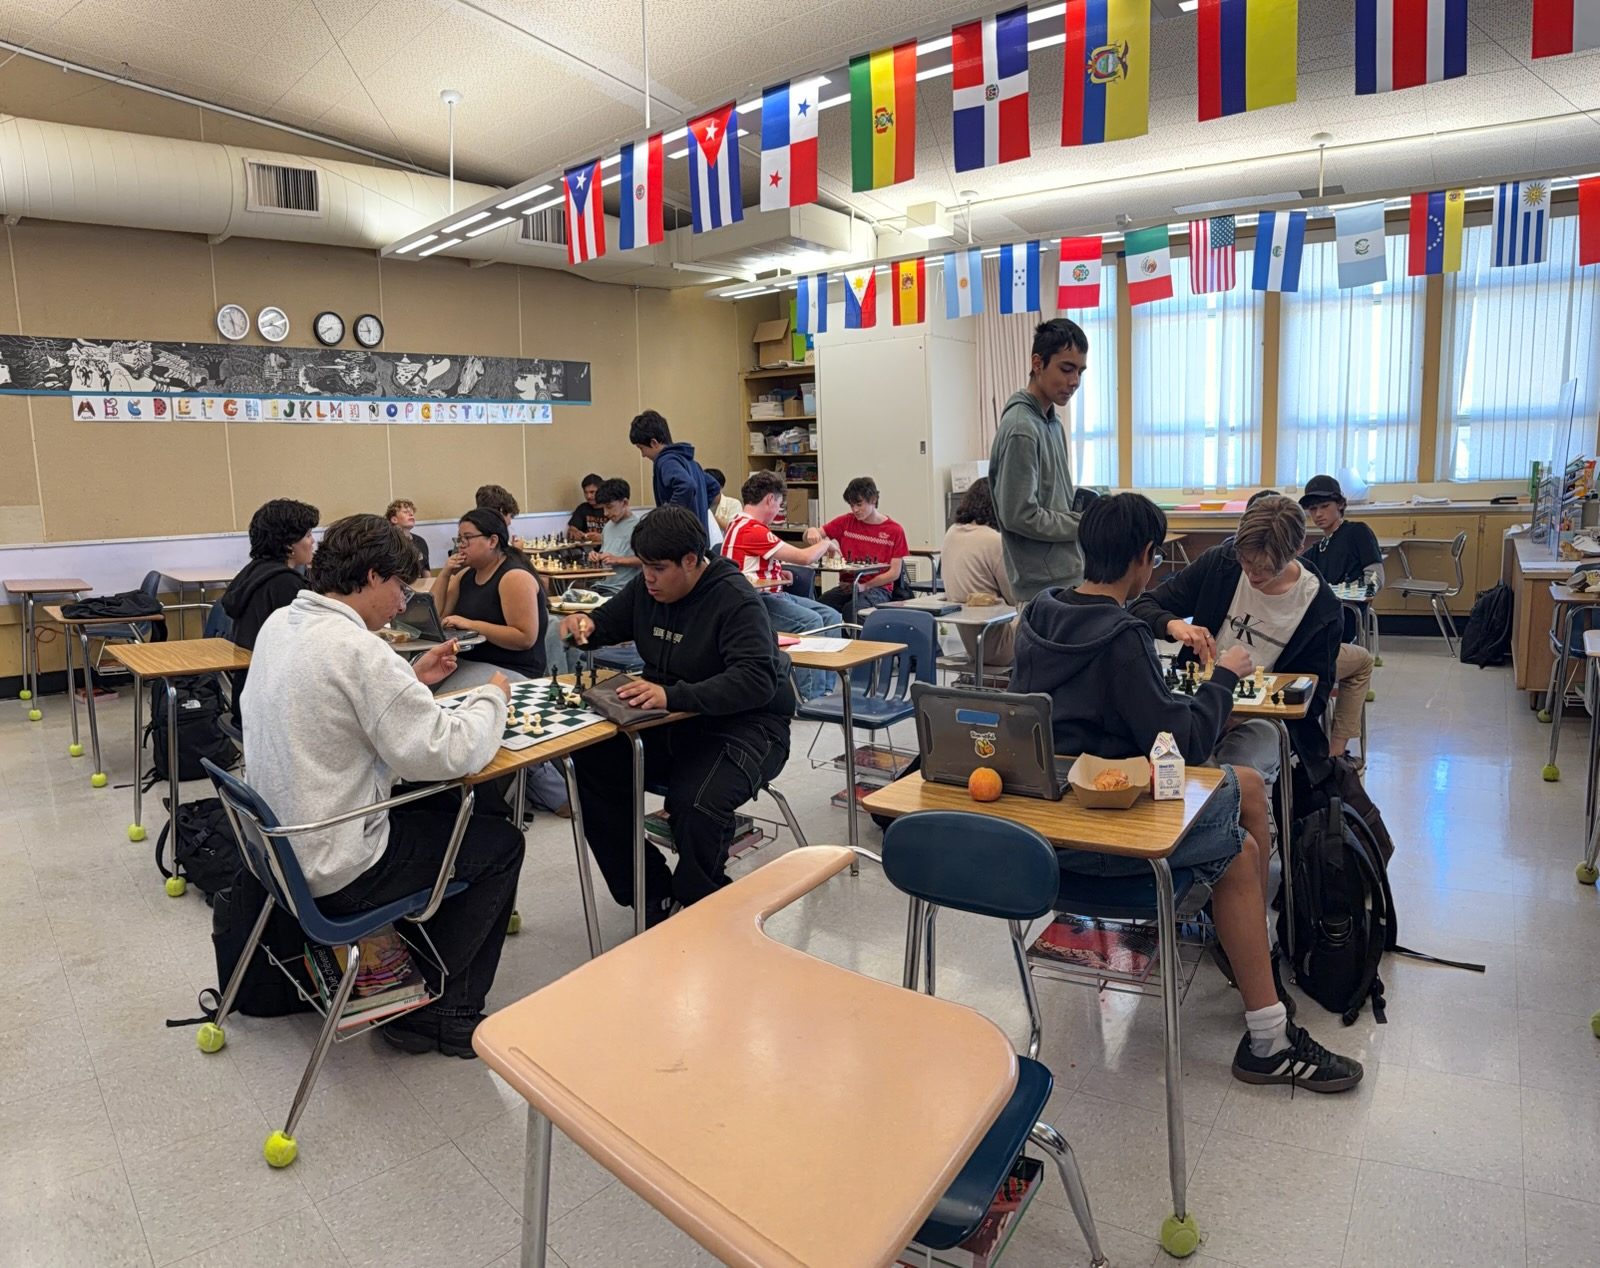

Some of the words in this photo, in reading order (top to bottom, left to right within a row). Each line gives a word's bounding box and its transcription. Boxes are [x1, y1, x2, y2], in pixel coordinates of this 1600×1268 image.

[153, 398, 167, 416] D
[178, 399, 191, 415] E
[223, 399, 238, 416] G
[283, 400, 295, 417] J
[299, 401, 312, 418] K
[316, 401, 327, 417] L
[329, 402, 342, 418] M
[386, 403, 398, 418] O
[405, 403, 413, 418] P
[449, 404, 457, 419] S
[462, 404, 471, 419] T
